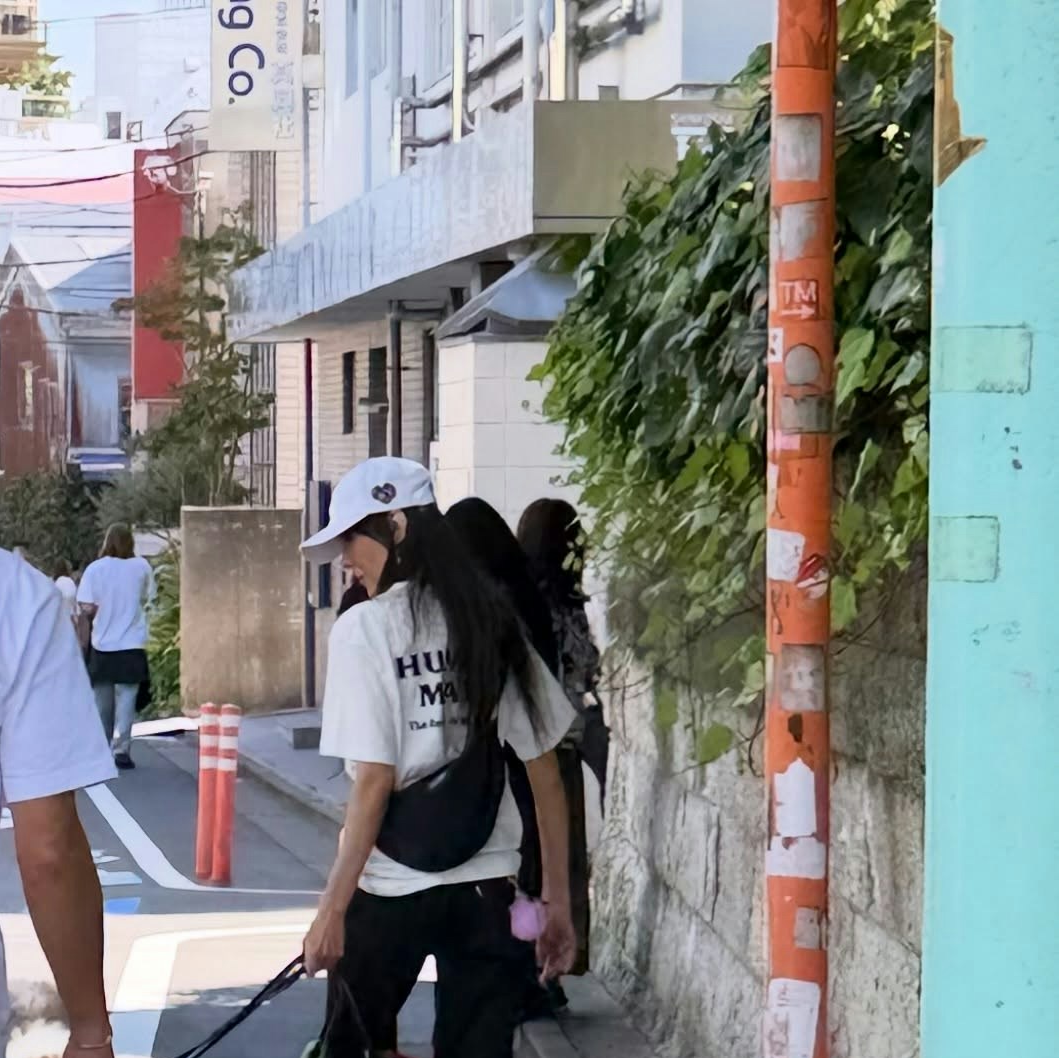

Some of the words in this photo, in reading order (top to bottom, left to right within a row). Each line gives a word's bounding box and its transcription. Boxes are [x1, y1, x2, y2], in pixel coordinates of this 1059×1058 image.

[217, 0, 254, 29] g
[228, 43, 265, 105] Co.
[395, 649, 451, 679] HU
[419, 682, 459, 707] MA
